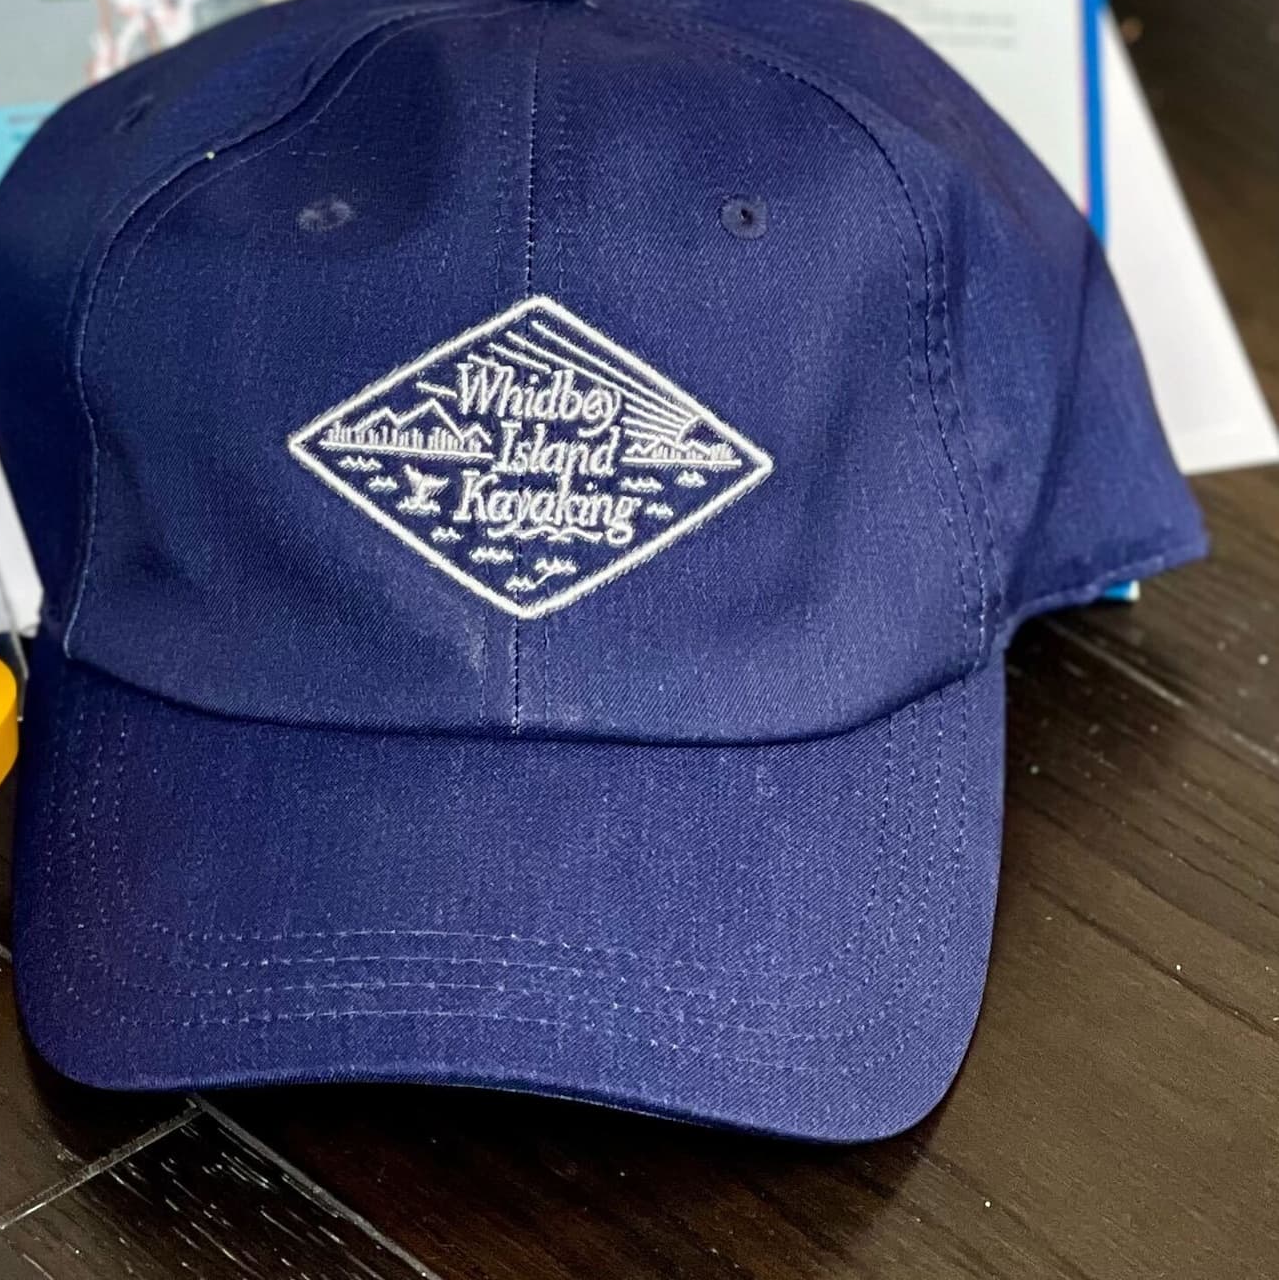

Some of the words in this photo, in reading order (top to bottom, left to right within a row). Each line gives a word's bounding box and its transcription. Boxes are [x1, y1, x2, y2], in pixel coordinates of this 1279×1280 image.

[456, 362, 623, 440] Whidbey
[490, 418, 622, 477] Island
[452, 469, 643, 547] Kayaking
